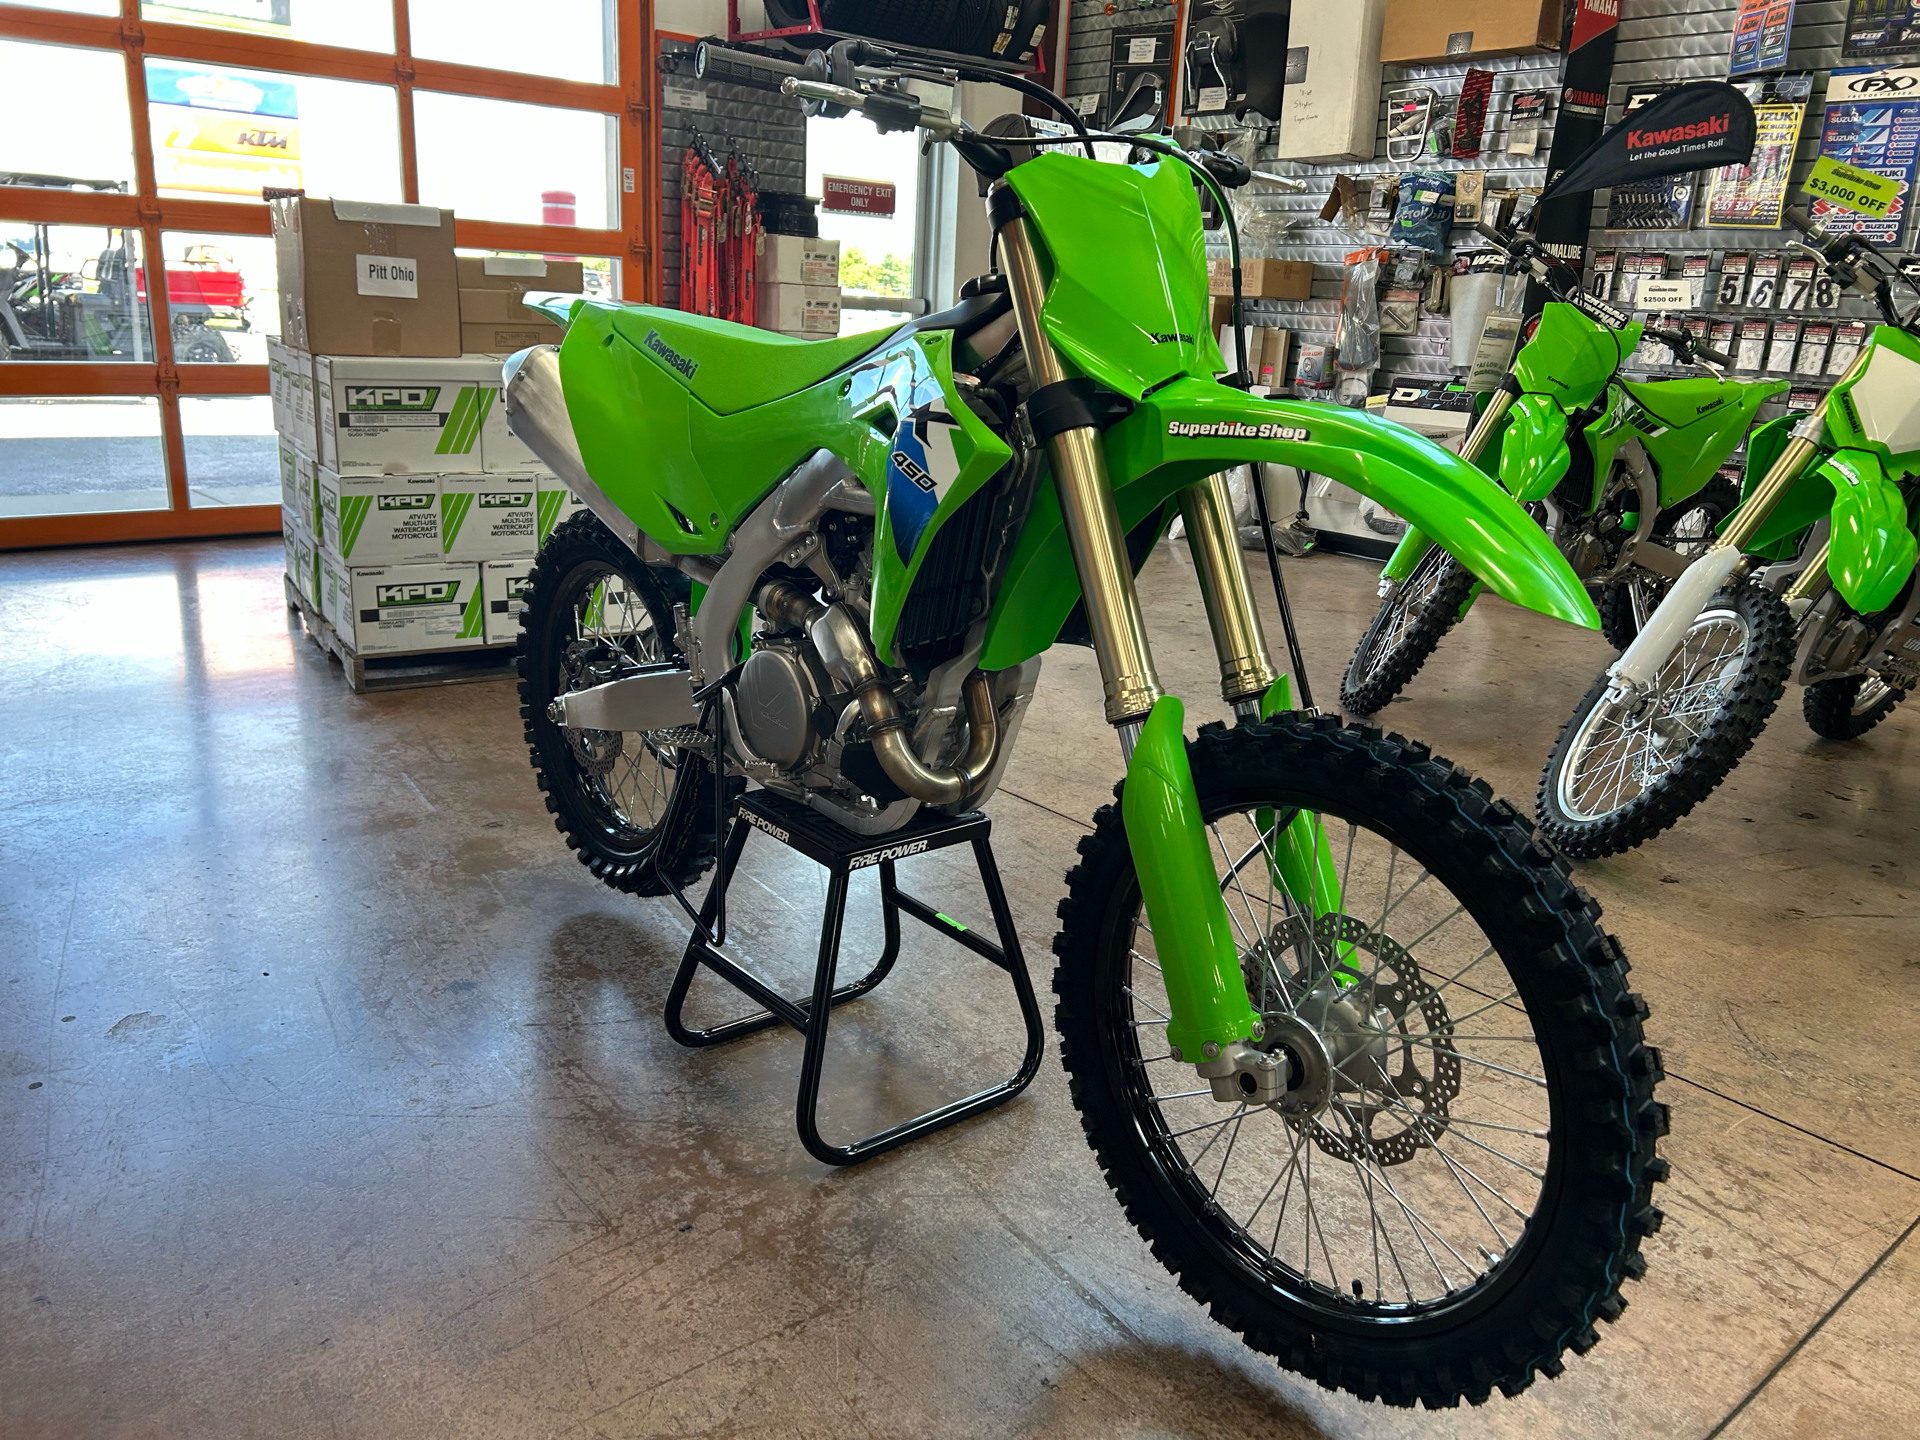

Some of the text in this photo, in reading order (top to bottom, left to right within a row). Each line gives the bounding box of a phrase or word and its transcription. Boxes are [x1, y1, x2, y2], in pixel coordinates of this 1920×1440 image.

[1584, 0, 1618, 16] YAMAHA
[1573, 89, 1606, 107] YAMAHA
[1756, 111, 1798, 121] UZUKI
[237, 129, 287, 149] KTM
[1626, 113, 1729, 150] Kawasaki
[1629, 138, 1724, 162] Let the Good Times Roll
[828, 182, 892, 198] EMERGENCY EXIT
[1809, 178, 1888, 211] $3,000 OFF
[1863, 179, 1882, 191] Shop
[850, 197, 869, 207] ONLY
[1541, 242, 1582, 259] YAMALUBE
[369, 264, 414, 281] Pitt Ohio
[1592, 273, 1606, 299] 0
[1720, 275, 1739, 304] 5
[1750, 280, 1774, 307] 6
[1788, 280, 1809, 311] 7
[1816, 278, 1833, 308] 8
[1151, 332, 1194, 346] Kawasaki
[644, 330, 699, 380] Kawasaki
[1547, 375, 1570, 390] Kawasaki
[1696, 396, 1724, 415] Kawasaki
[1840, 391, 1861, 434] Kawasaki
[1168, 420, 1310, 441] Superbike Shop
[891, 452, 938, 492] 450
[379, 496, 427, 507] KPO
[480, 494, 525, 505] KPO
[379, 583, 448, 602] KPO
[757, 817, 790, 843] POWER
[879, 839, 928, 862] POWER
